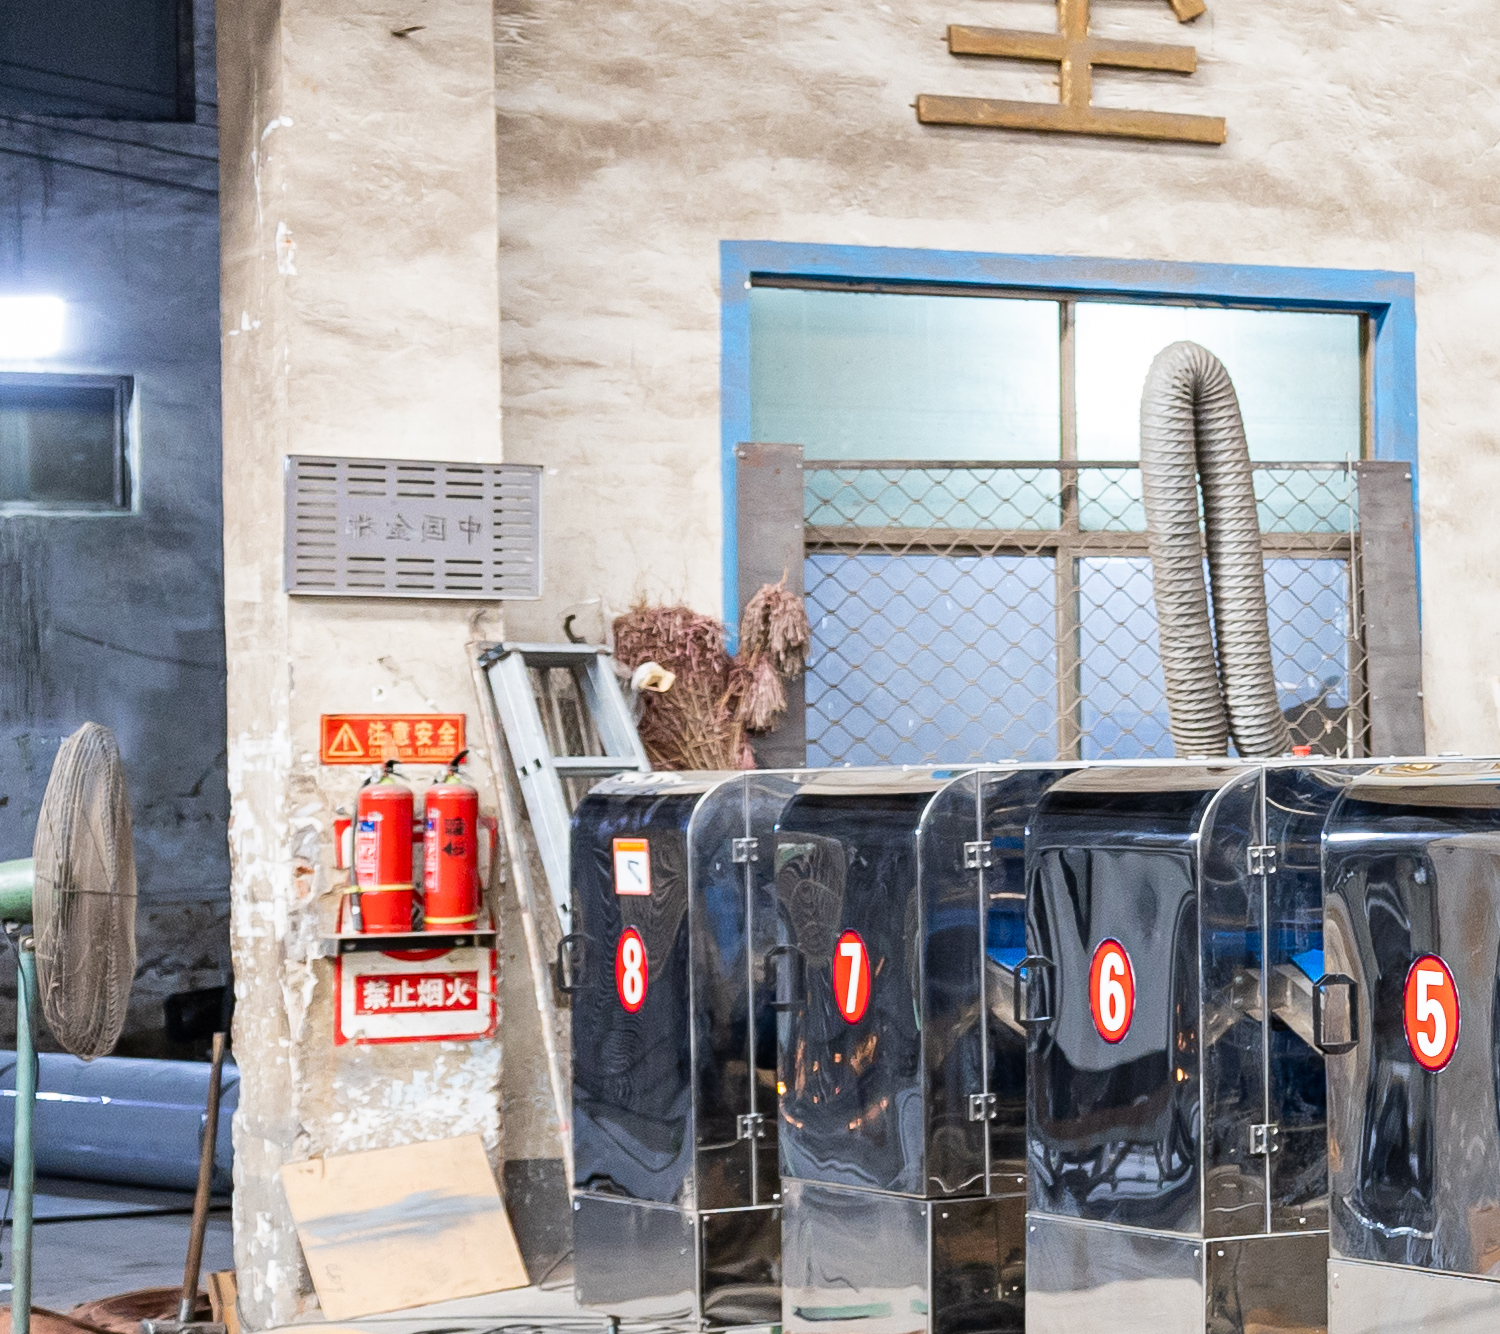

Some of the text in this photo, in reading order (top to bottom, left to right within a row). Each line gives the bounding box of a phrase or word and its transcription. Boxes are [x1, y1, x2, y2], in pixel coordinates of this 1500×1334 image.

[367, 721, 457, 746] 注意安全
[362, 977, 473, 1011] 禁止烟火
[623, 938, 642, 1004] 8
[841, 943, 861, 1013] 7
[1100, 953, 1125, 1031] 6
[1417, 970, 1446, 1057] 5
